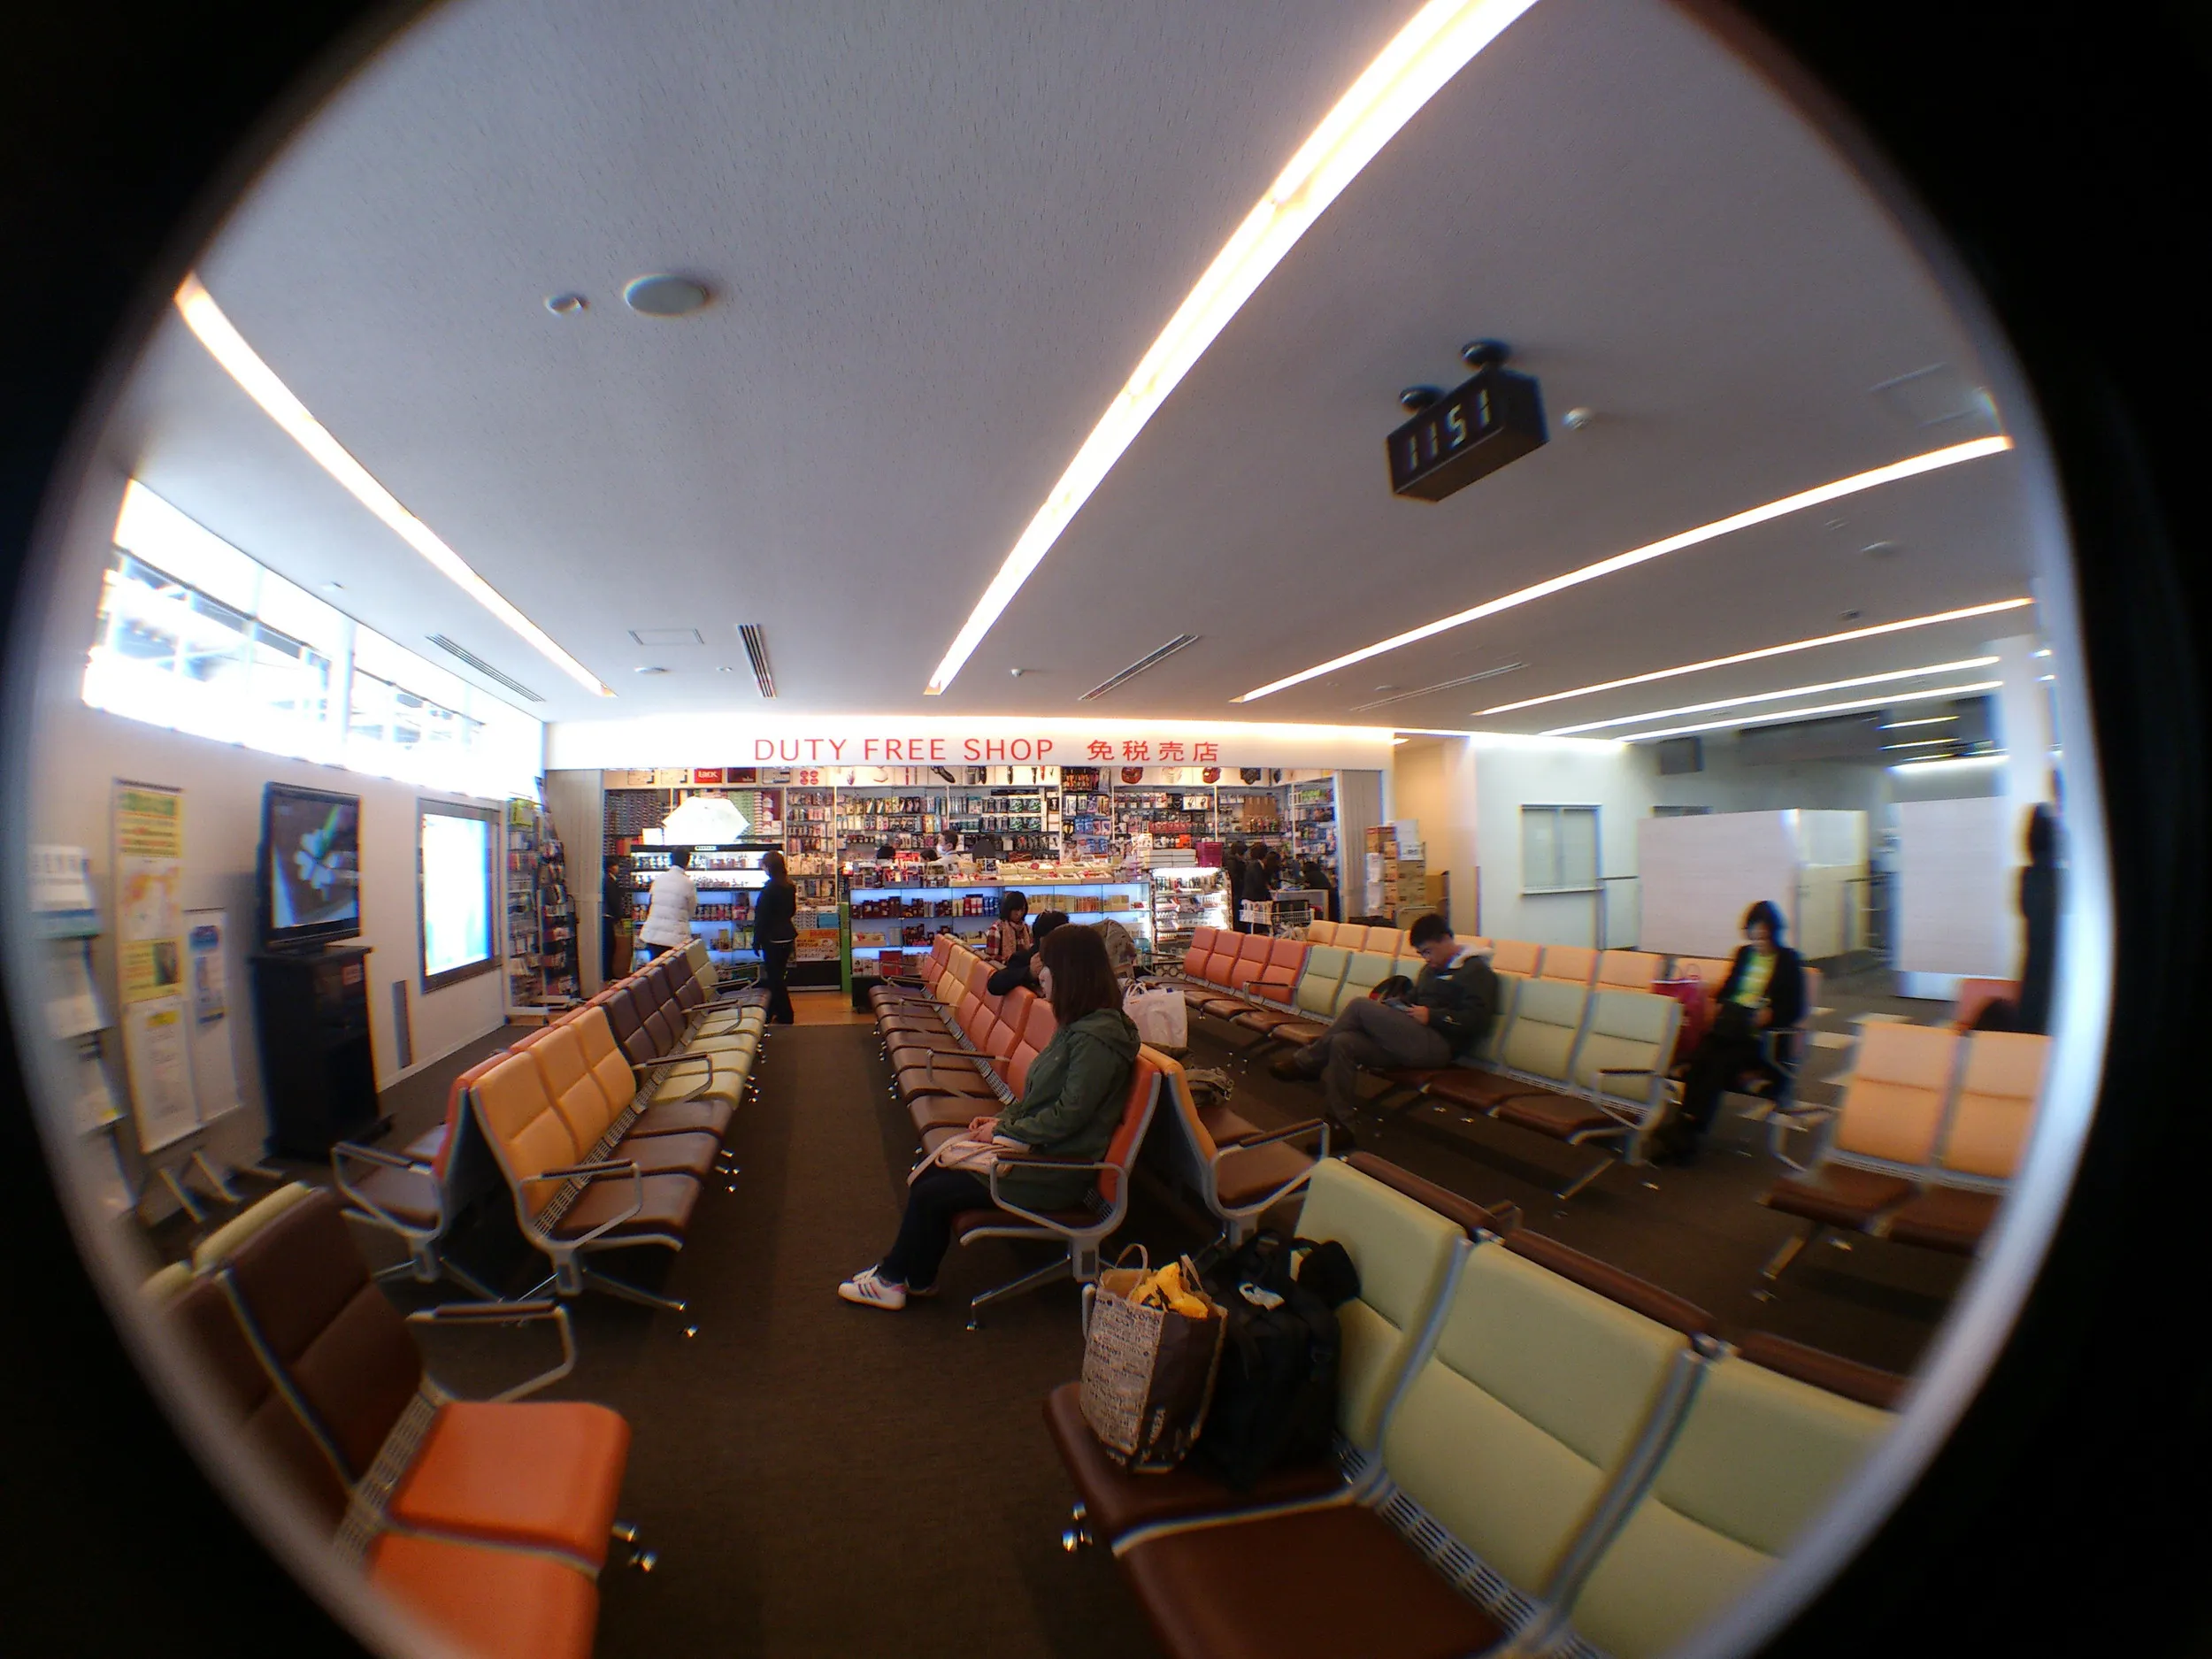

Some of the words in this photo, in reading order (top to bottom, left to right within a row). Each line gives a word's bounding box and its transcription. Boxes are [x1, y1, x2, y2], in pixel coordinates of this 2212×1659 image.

[1409, 388, 1491, 471] 1151
[755, 739, 846, 760] DUTY
[864, 739, 946, 760] FREE
[964, 739, 1053, 761] SHOP
[1087, 739, 1218, 762] 免税売店
